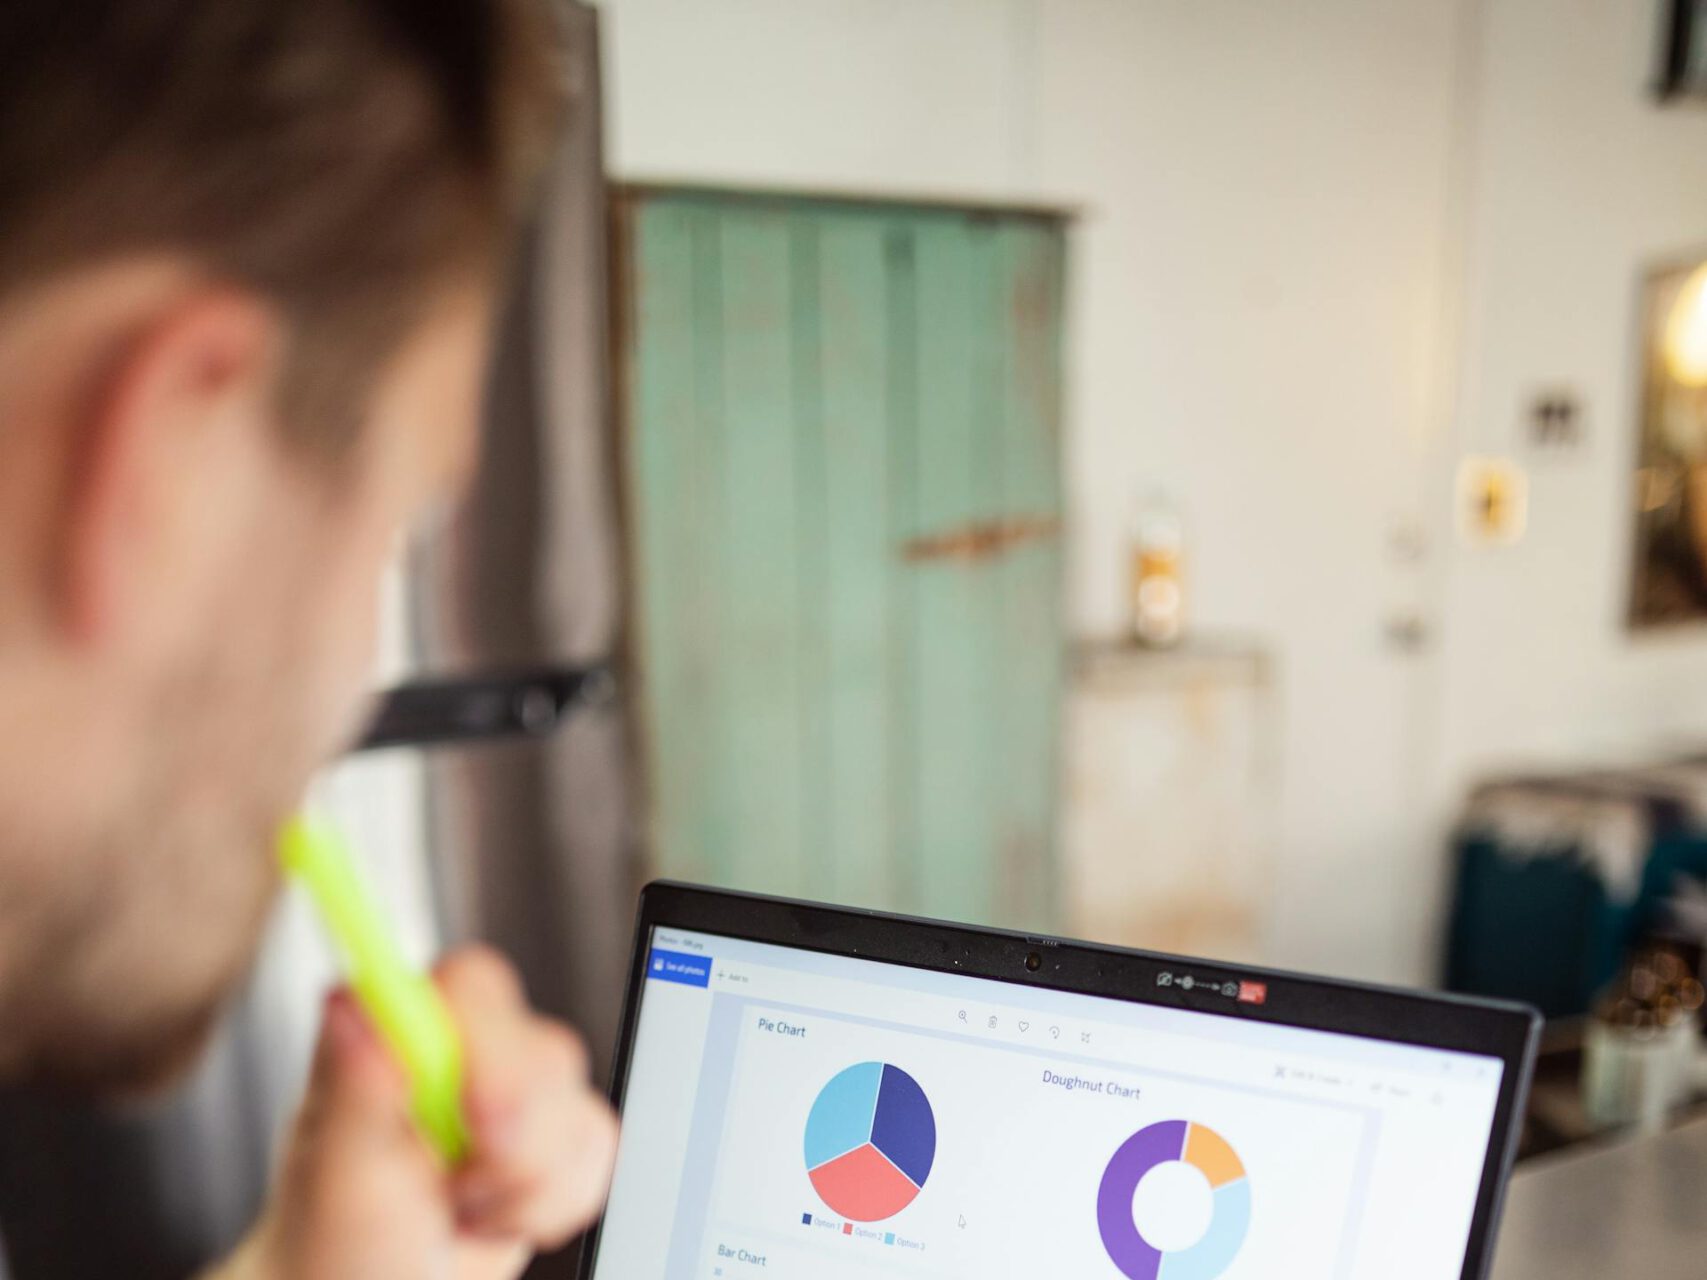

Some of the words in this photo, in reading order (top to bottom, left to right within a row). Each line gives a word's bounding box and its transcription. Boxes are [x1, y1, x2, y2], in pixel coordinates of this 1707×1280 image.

[757, 1017, 775, 1032] Pie
[776, 1020, 806, 1038] Chart
[1042, 1068, 1103, 1092] Doughnut
[1106, 1081, 1141, 1100] Chart
[813, 1217, 835, 1231] Option
[855, 1227, 877, 1241] Option
[896, 1236, 920, 1250] Option
[717, 1243, 736, 1259] Bar
[737, 1248, 767, 1267] Chart
